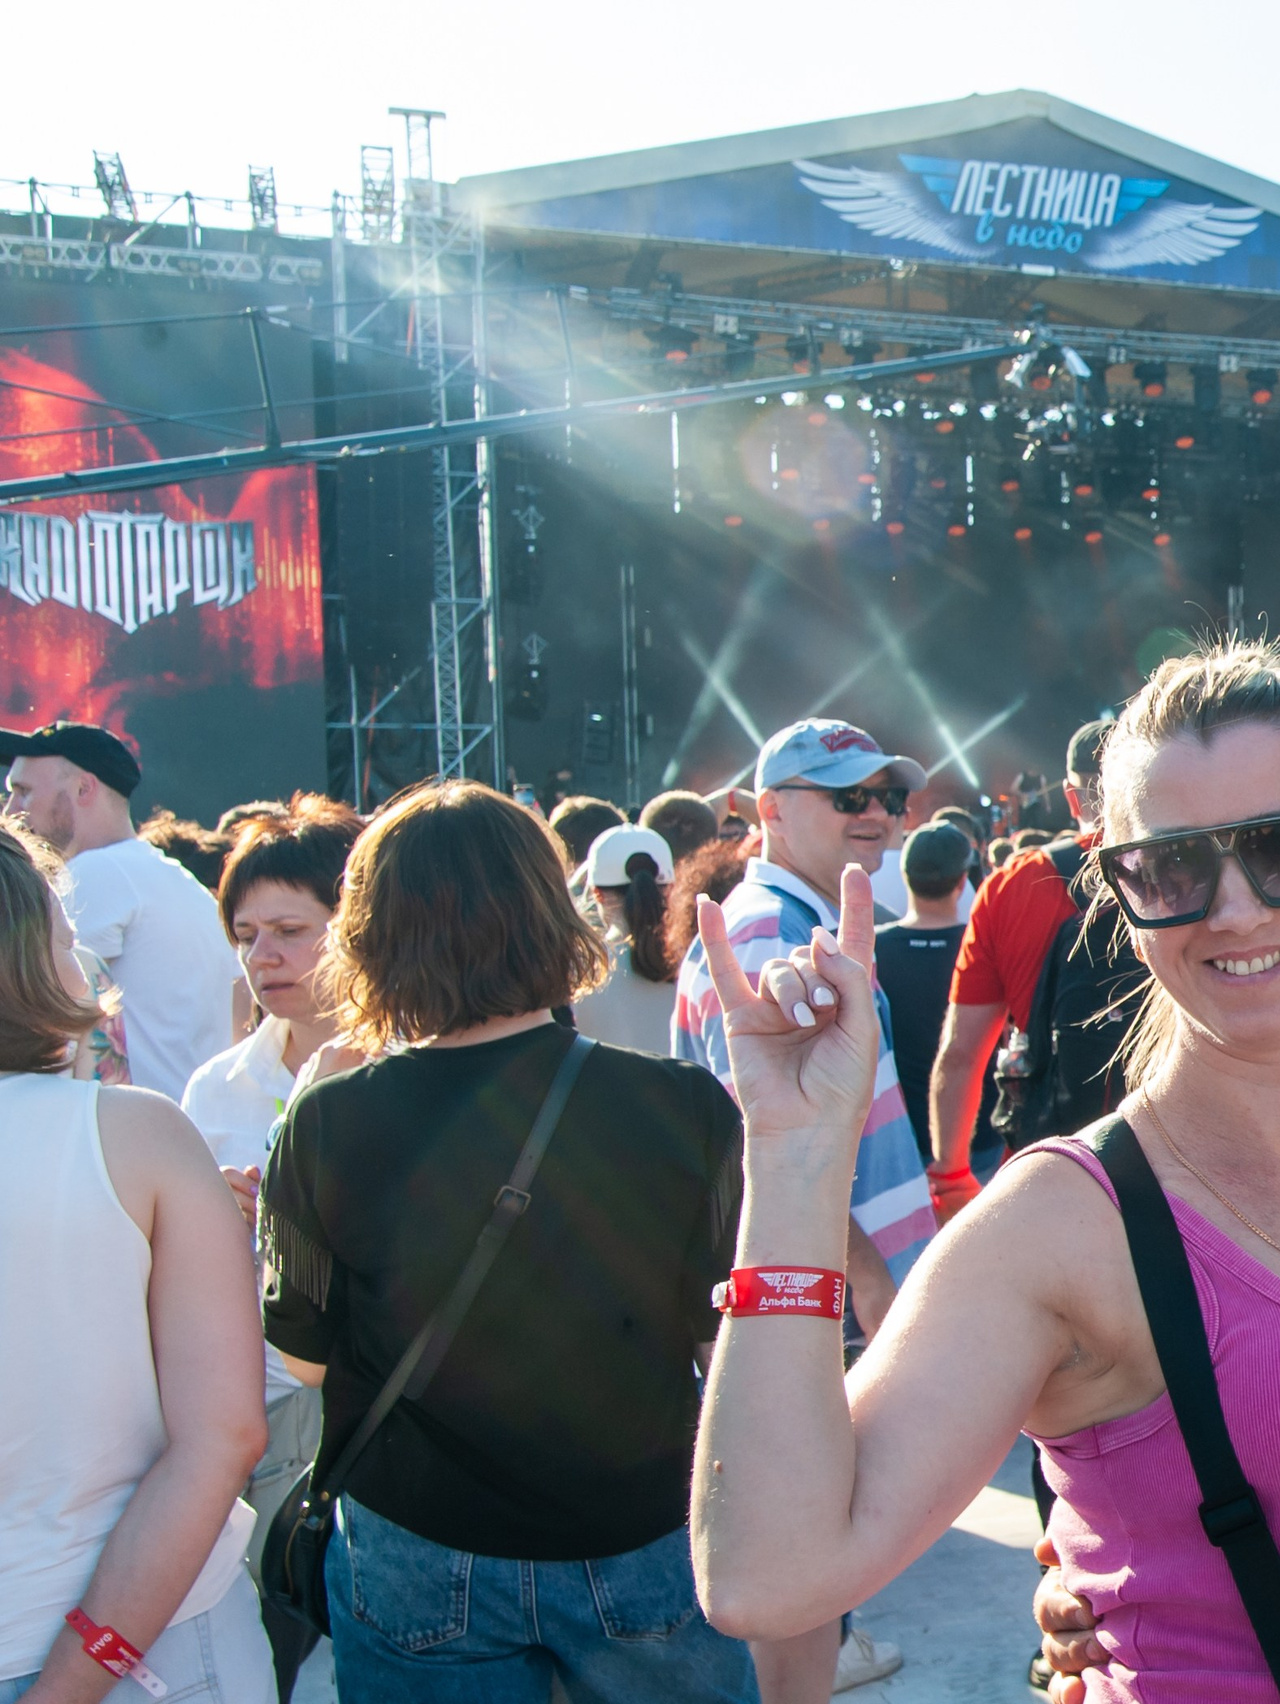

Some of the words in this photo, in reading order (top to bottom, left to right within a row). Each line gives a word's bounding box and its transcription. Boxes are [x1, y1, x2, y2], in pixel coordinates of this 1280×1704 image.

[951, 160, 1122, 230] ЛЕСТНИЦА
[975, 214, 995, 244] в
[1006, 218, 1084, 254] небо
[759, 1296, 796, 1309] Альфа
[797, 1296, 822, 1308] Банк
[89, 1632, 114, 1654] ФАН
